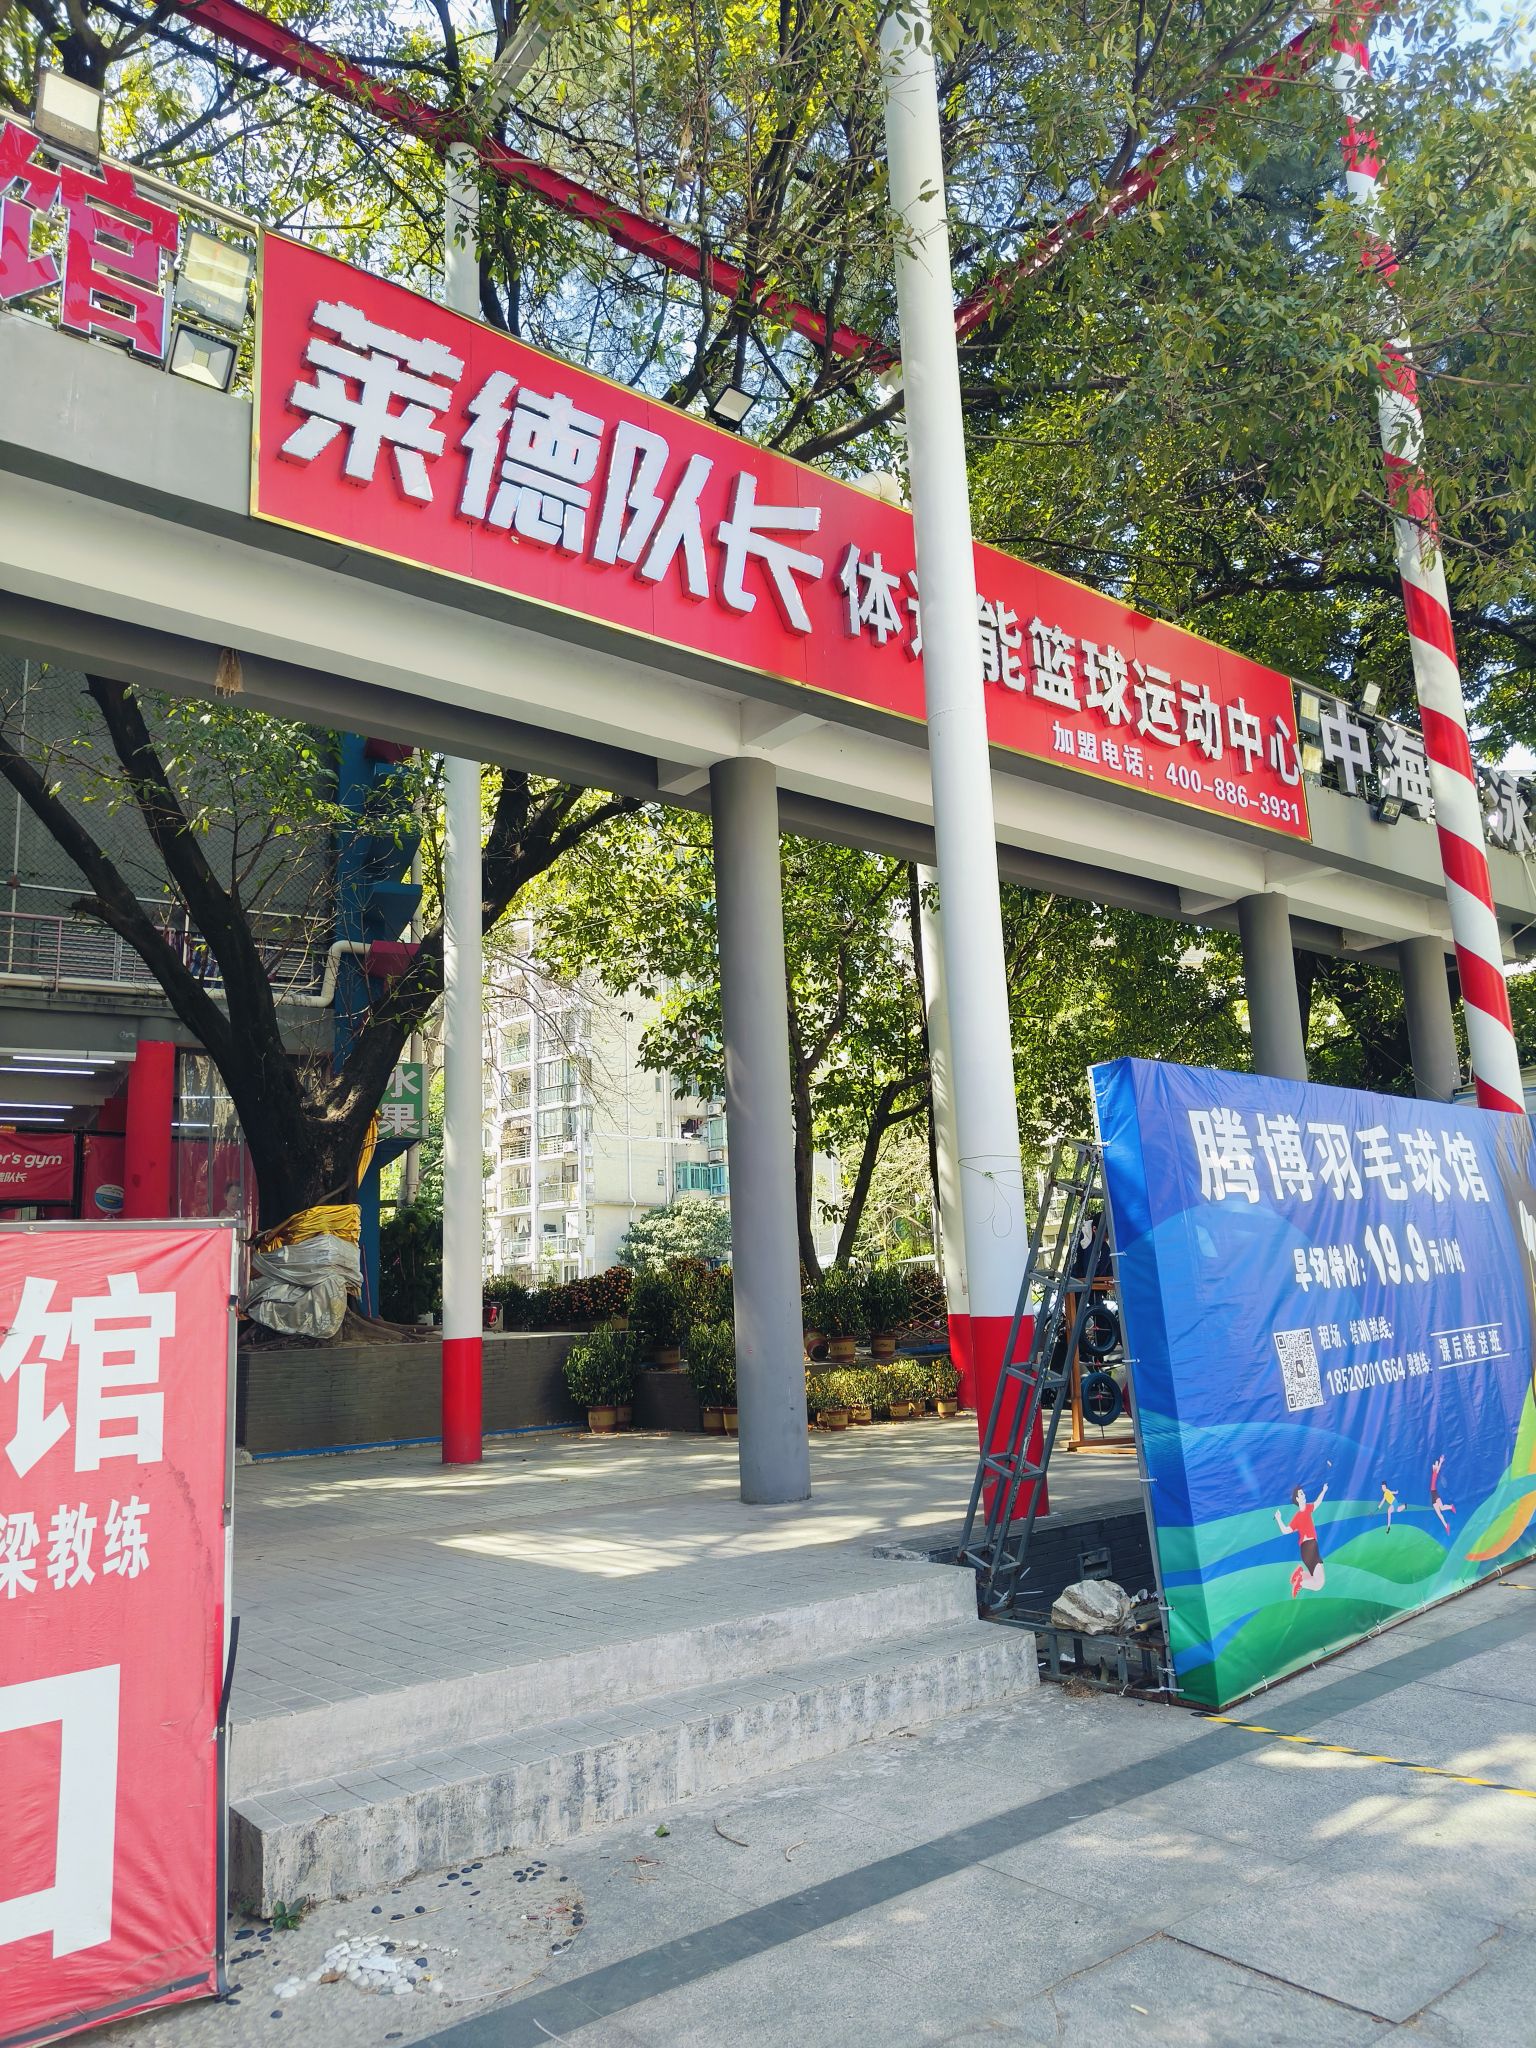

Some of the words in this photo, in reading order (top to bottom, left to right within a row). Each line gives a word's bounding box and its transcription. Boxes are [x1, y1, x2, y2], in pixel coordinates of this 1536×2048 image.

[278, 300, 826, 635] 莱德队长
[1320, 700, 1534, 852] 中海泳
[379, 1064, 421, 1136] 水果
[0, 1152, 22, 1165] r's
[24, 1154, 63, 1168] gym
[1187, 1107, 1491, 1205] 腾博羽毛球馆
[0, 1273, 176, 1479] 馆
[1326, 1356, 1406, 1396] 18520201664
[1438, 1328, 1502, 1362] 课后接送班
